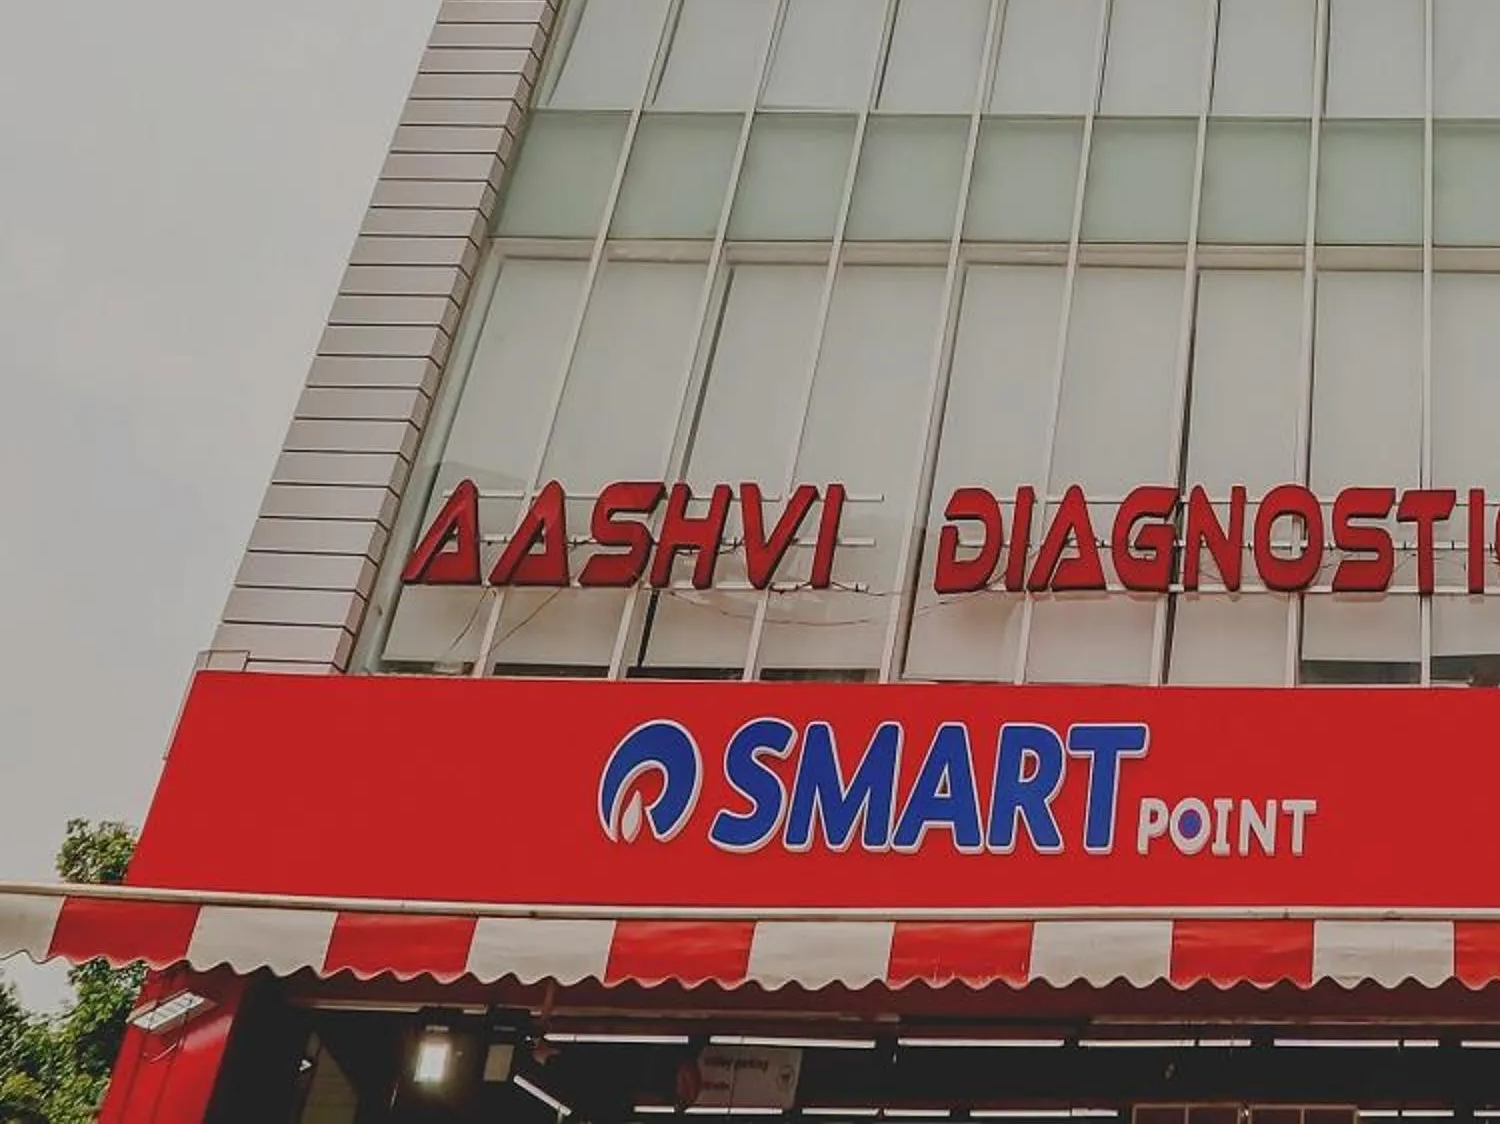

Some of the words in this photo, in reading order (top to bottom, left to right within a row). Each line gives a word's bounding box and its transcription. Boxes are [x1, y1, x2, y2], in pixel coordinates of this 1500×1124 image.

[402, 479, 846, 590] AASHVI
[708, 716, 1150, 854] SMART
[1136, 797, 1317, 856] POINT
